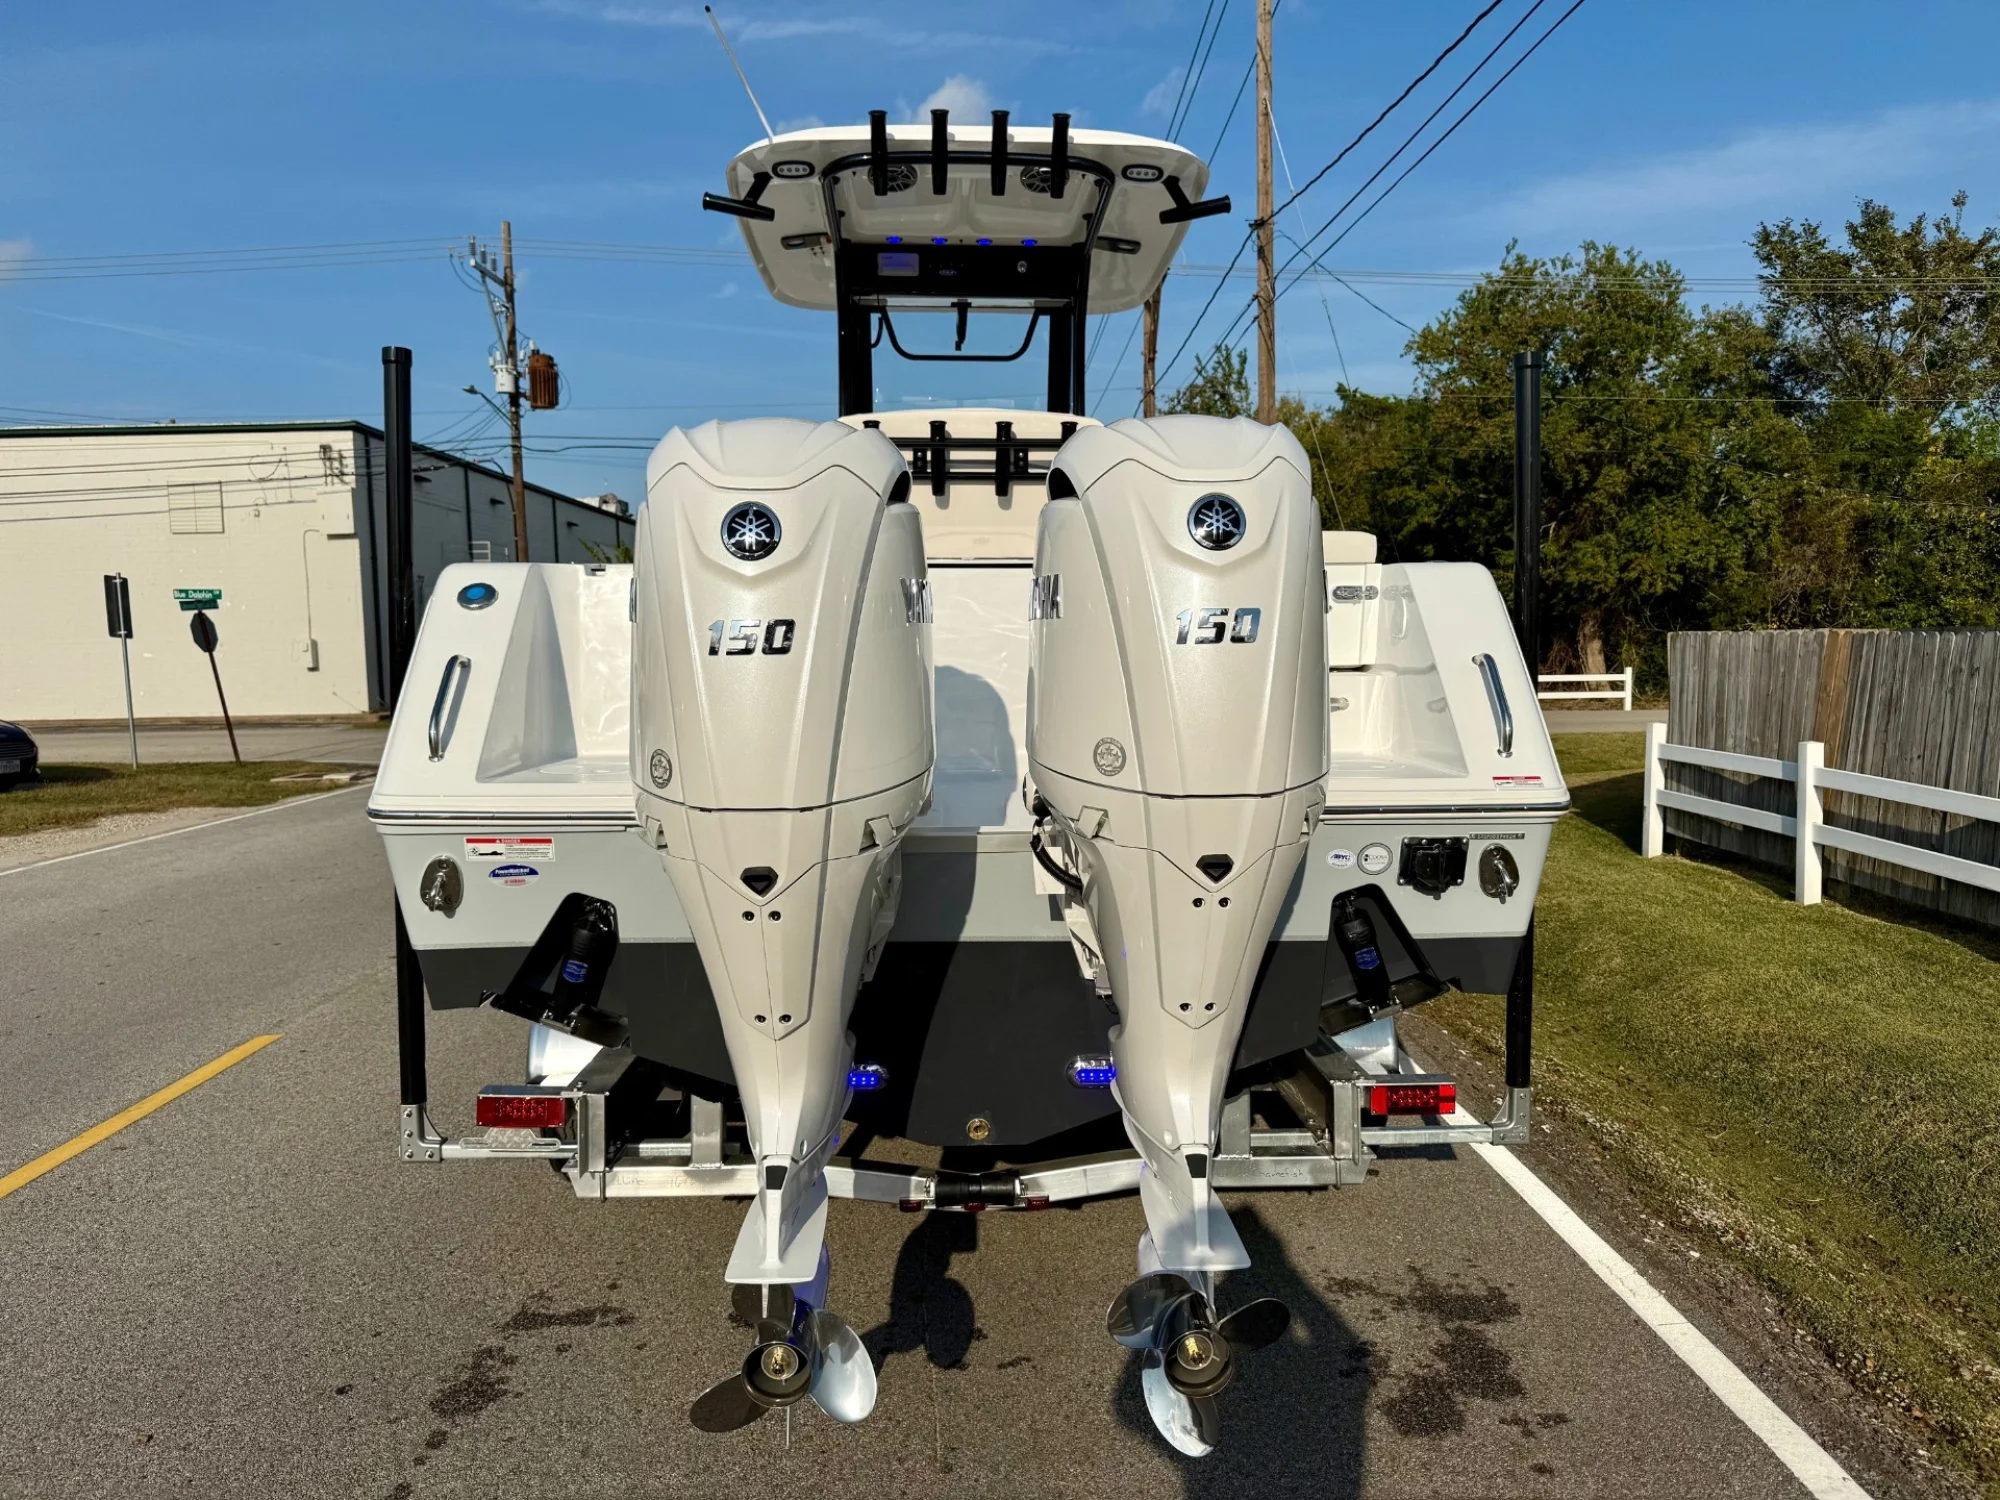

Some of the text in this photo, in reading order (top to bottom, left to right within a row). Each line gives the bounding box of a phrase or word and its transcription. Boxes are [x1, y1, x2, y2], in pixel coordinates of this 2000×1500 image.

[174, 590, 186, 598] Blue
[188, 590, 212, 599] Dolphin
[708, 619, 796, 655] 150
[1176, 607, 1261, 644] 150
